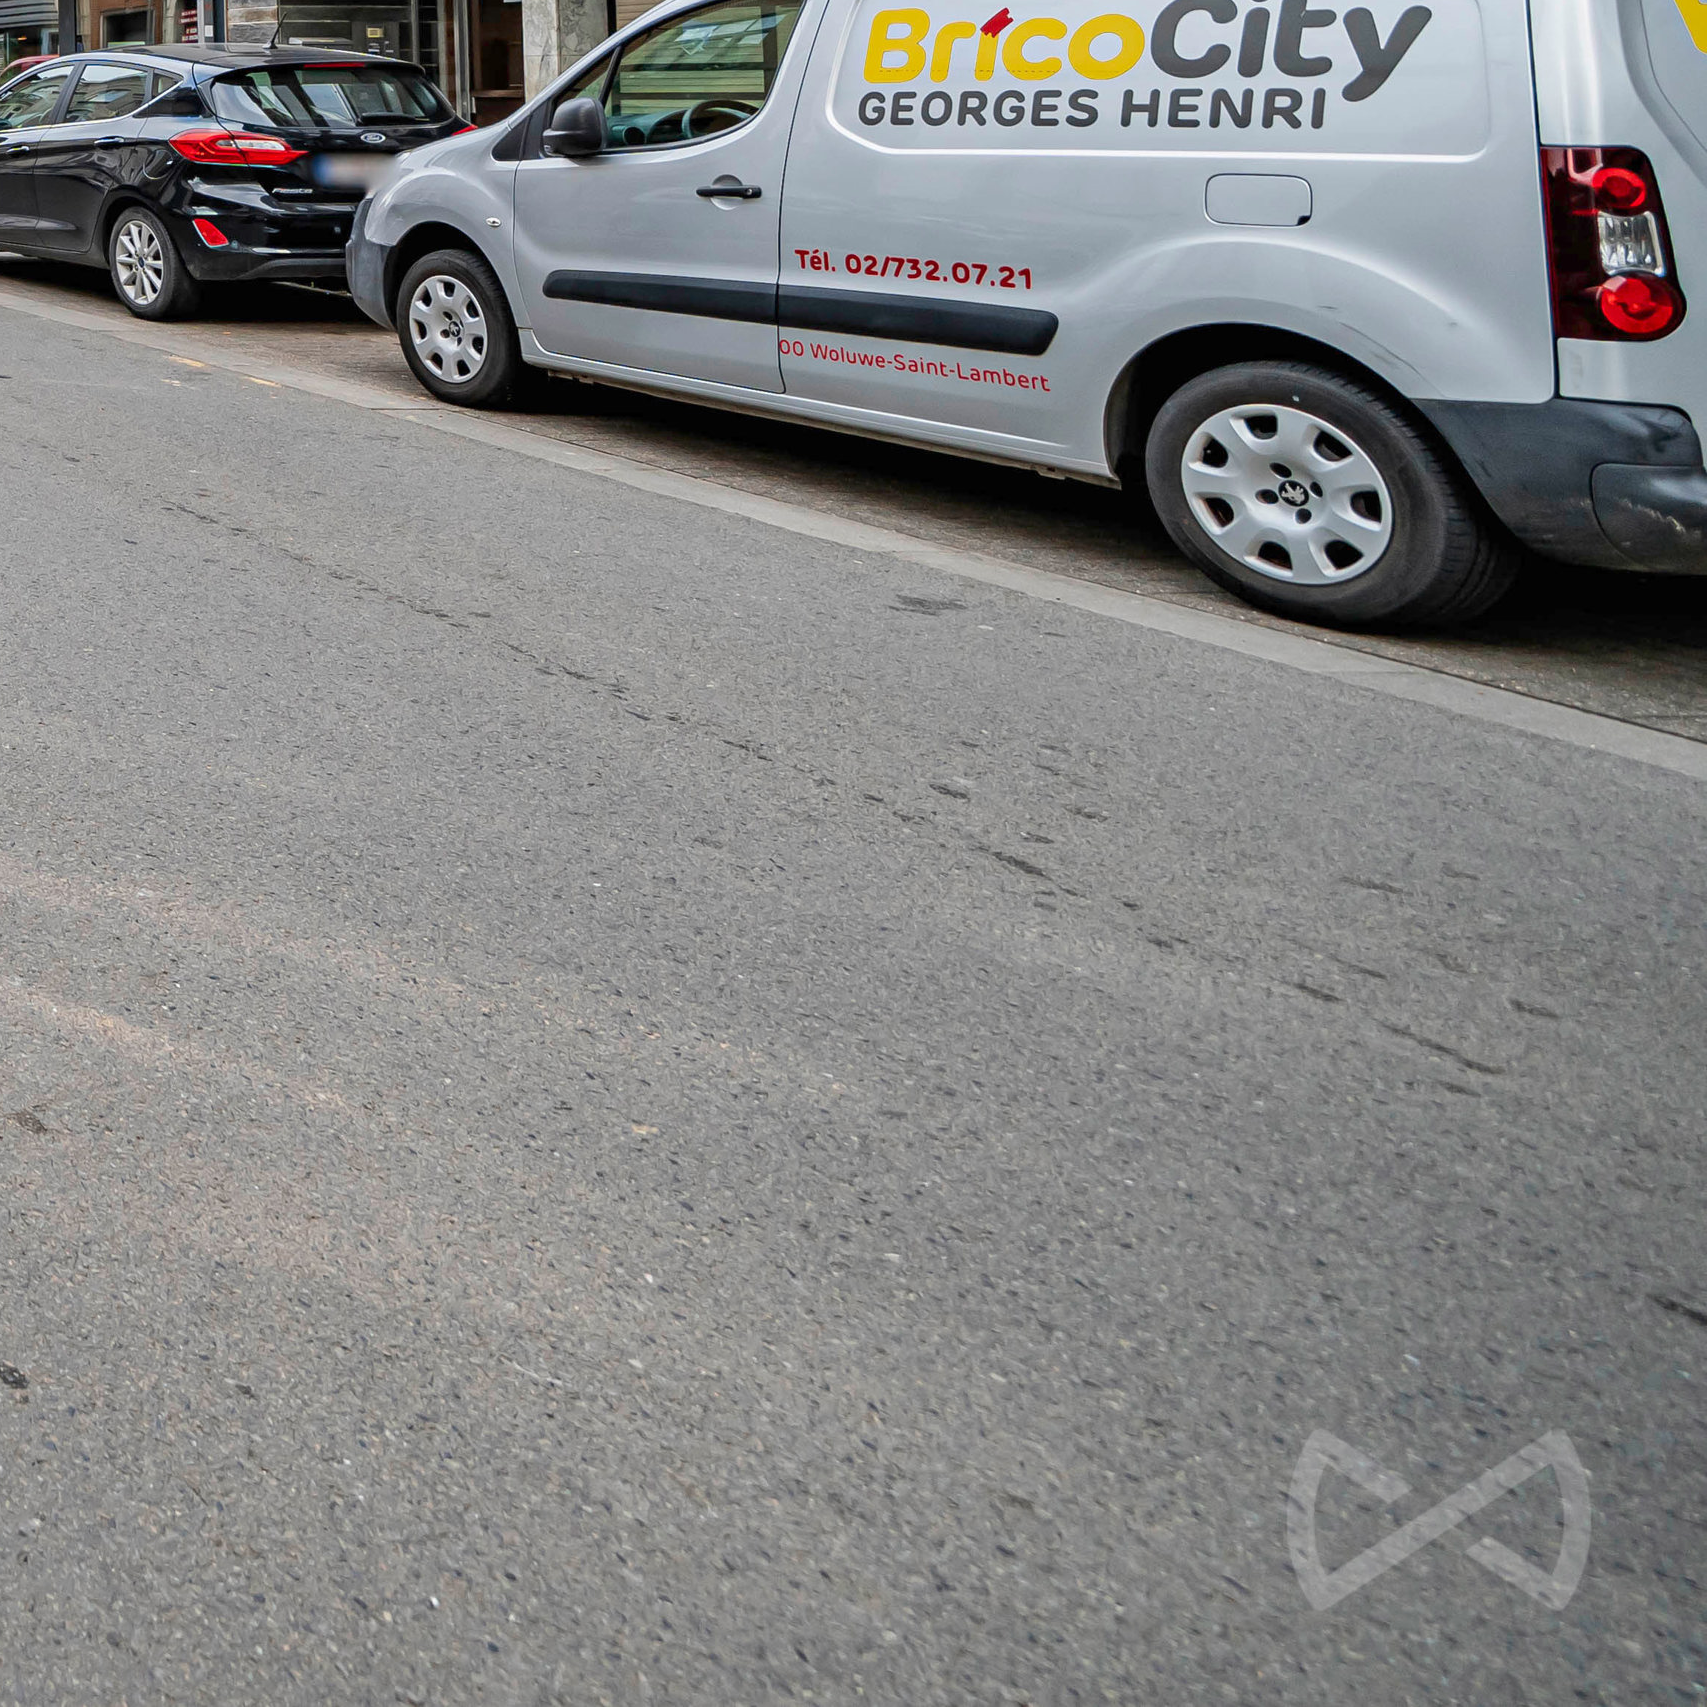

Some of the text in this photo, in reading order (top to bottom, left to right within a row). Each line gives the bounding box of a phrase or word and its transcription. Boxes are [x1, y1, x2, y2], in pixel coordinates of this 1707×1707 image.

[858, 87, 1326, 130] GEORGES HENRI
[794, 249, 1033, 290] Tél. 02/732.07.21
[809, 342, 1052, 392] Woluwe-Saint-Lambert
